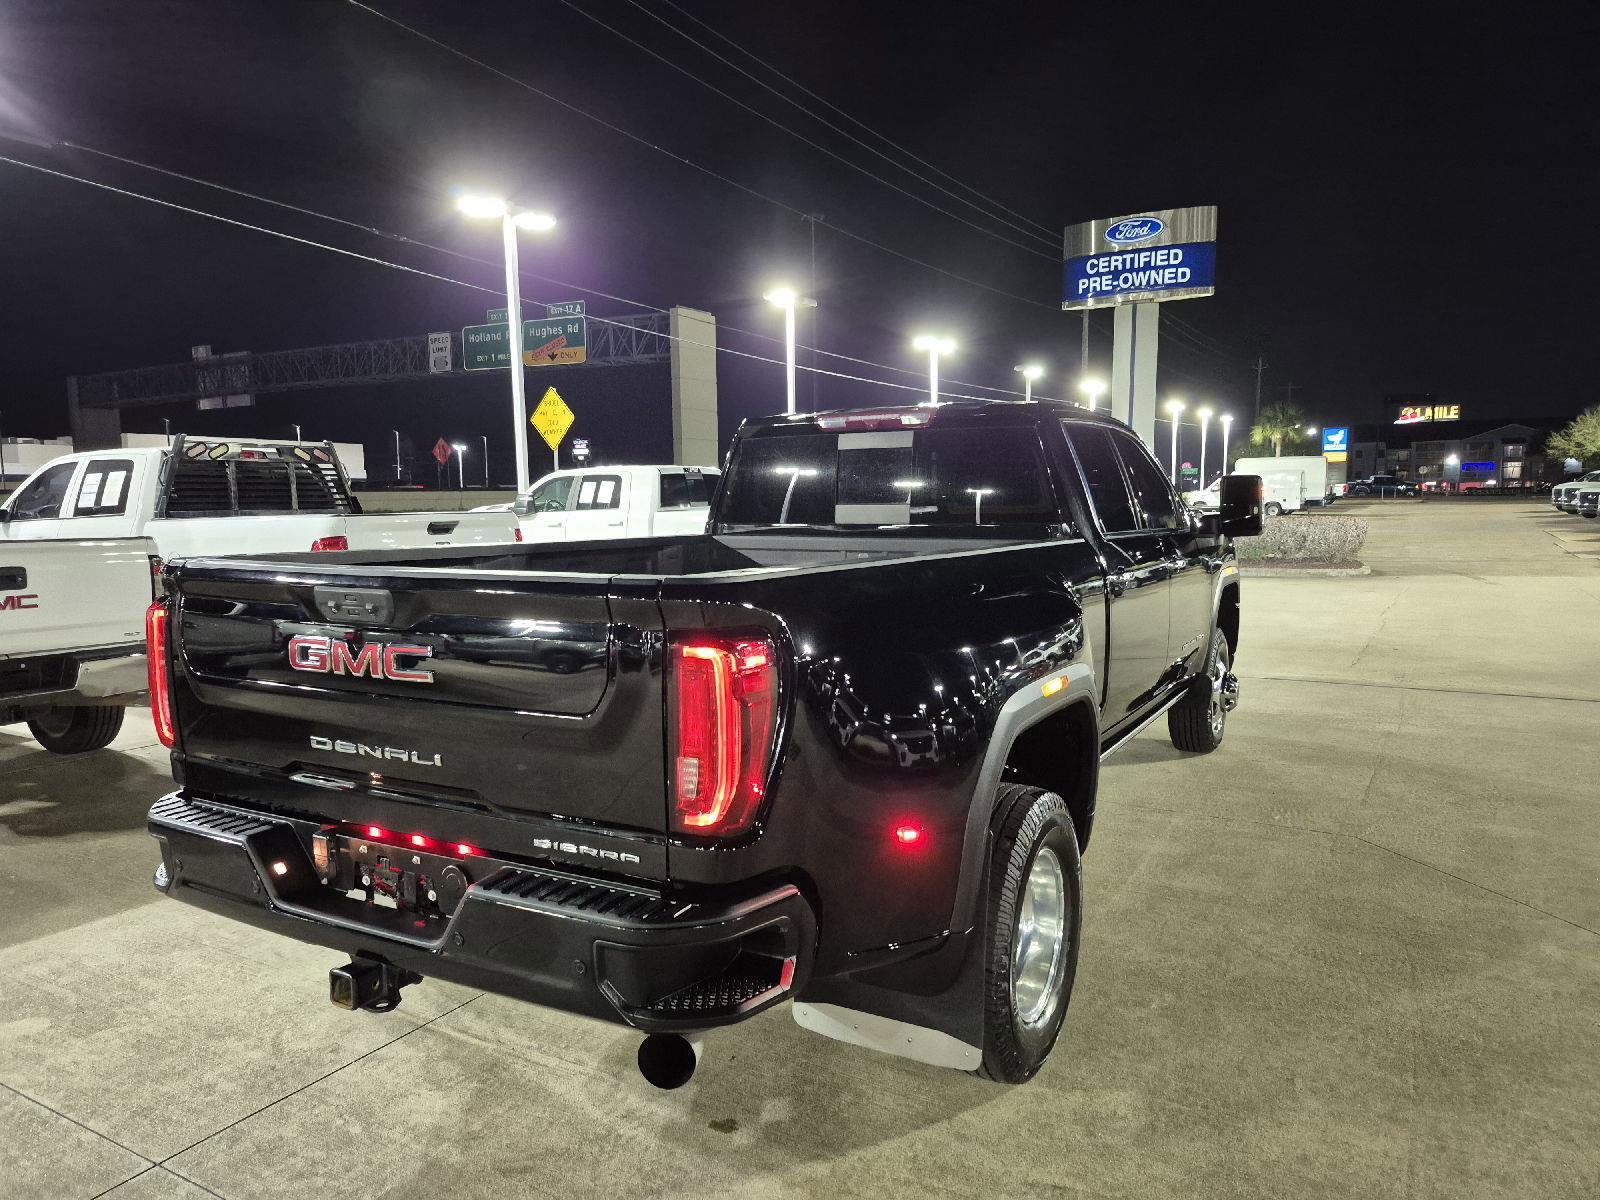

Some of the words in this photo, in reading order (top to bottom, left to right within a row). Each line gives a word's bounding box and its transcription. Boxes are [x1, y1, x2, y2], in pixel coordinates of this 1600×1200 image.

[1115, 220, 1151, 239] Ford
[1086, 248, 1183, 275] CERTIFIED
[1078, 267, 1191, 295] PRE-OWNED
[490, 312, 502, 321] EXIT
[550, 306, 563, 315] EXIT
[575, 304, 582, 312] A
[468, 331, 502, 344] Holland
[529, 325, 563, 338] Hughes
[567, 322, 579, 334] Rd
[476, 355, 488, 363] EXIT
[560, 351, 578, 360] ONLY
[0, 594, 39, 610] MC
[289, 634, 434, 684] GMC
[310, 735, 442, 767] DENALI
[533, 838, 641, 865] SIERRA
